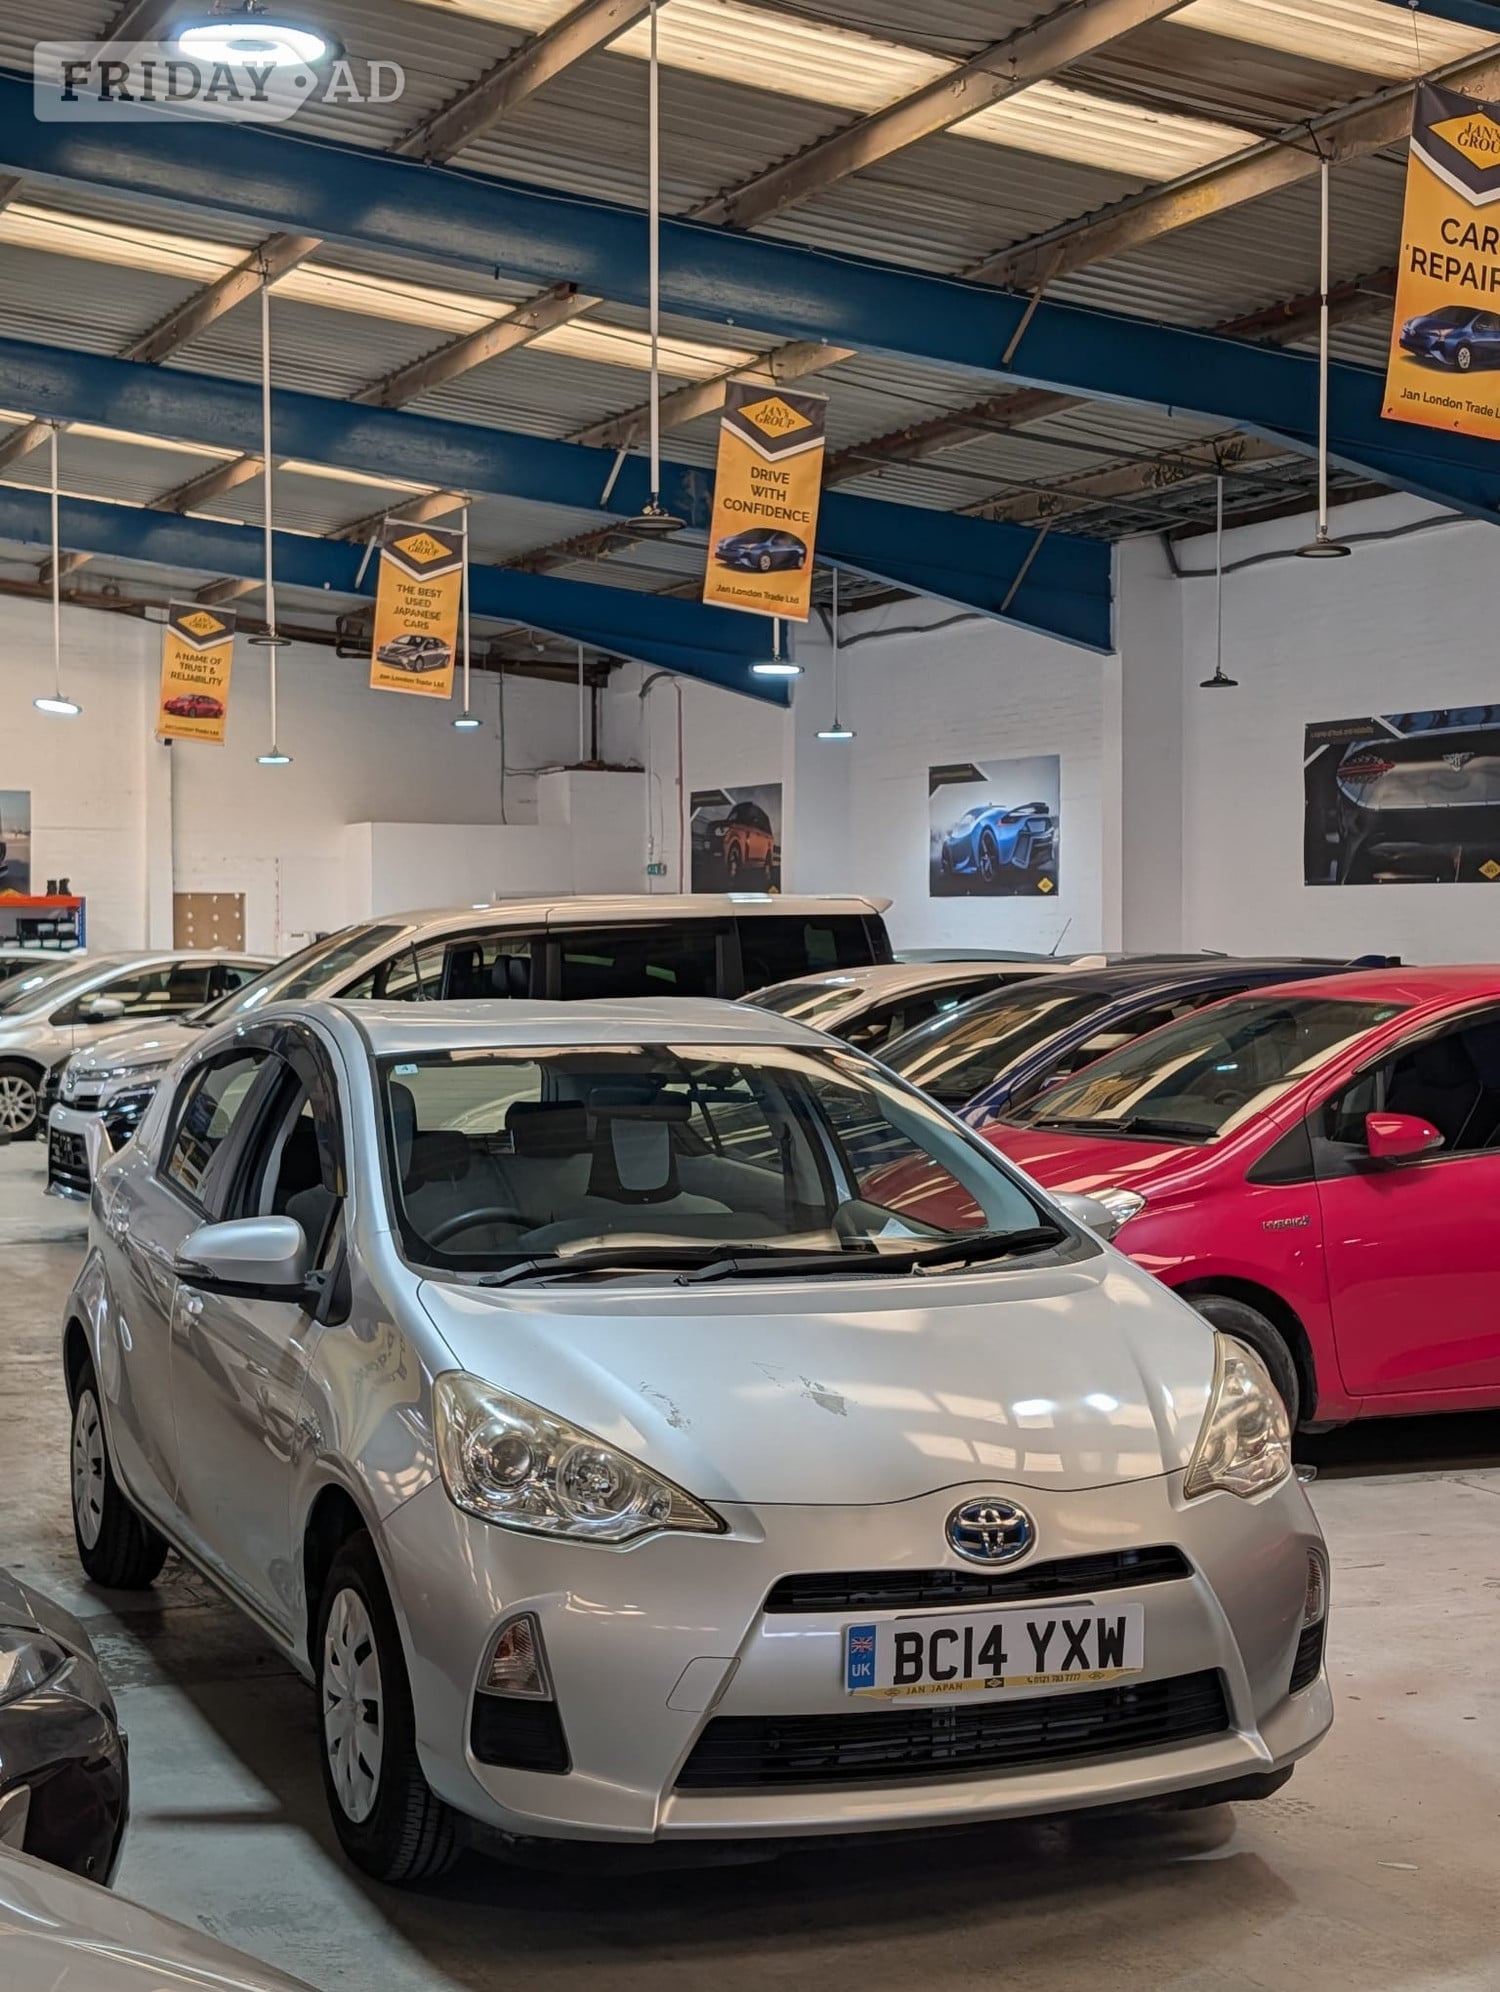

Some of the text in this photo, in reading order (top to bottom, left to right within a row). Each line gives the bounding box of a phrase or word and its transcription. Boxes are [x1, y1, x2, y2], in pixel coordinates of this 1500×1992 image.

[1457, 131, 1500, 154] GROU
[1440, 218, 1499, 255] CAR
[1400, 387, 1420, 400] Jan
[1423, 392, 1463, 410] London
[1465, 401, 1494, 417] Trade
[754, 413, 795, 428] GROUP
[751, 466, 790, 485] DRIVE
[751, 484, 787, 501] WITH
[723, 498, 810, 523] CONFIDENCE
[396, 584, 443, 598] THE BEST
[716, 584, 731, 593] Jan
[731, 586, 762, 598] London
[763, 591, 784, 602] Trade
[405, 596, 431, 608] USED
[392, 605, 441, 621] JAPANESE
[403, 618, 430, 630] CARS
[175, 652, 223, 666] A NAME OF
[179, 661, 216, 675] TRUST &
[170, 671, 223, 687] RELIABILITY
[893, 1616, 1127, 1686] BC14 YXW
[852, 1662, 871, 1677] UK
[906, 1685, 926, 1695] JAN
[931, 1681, 963, 1693] JAPAN
